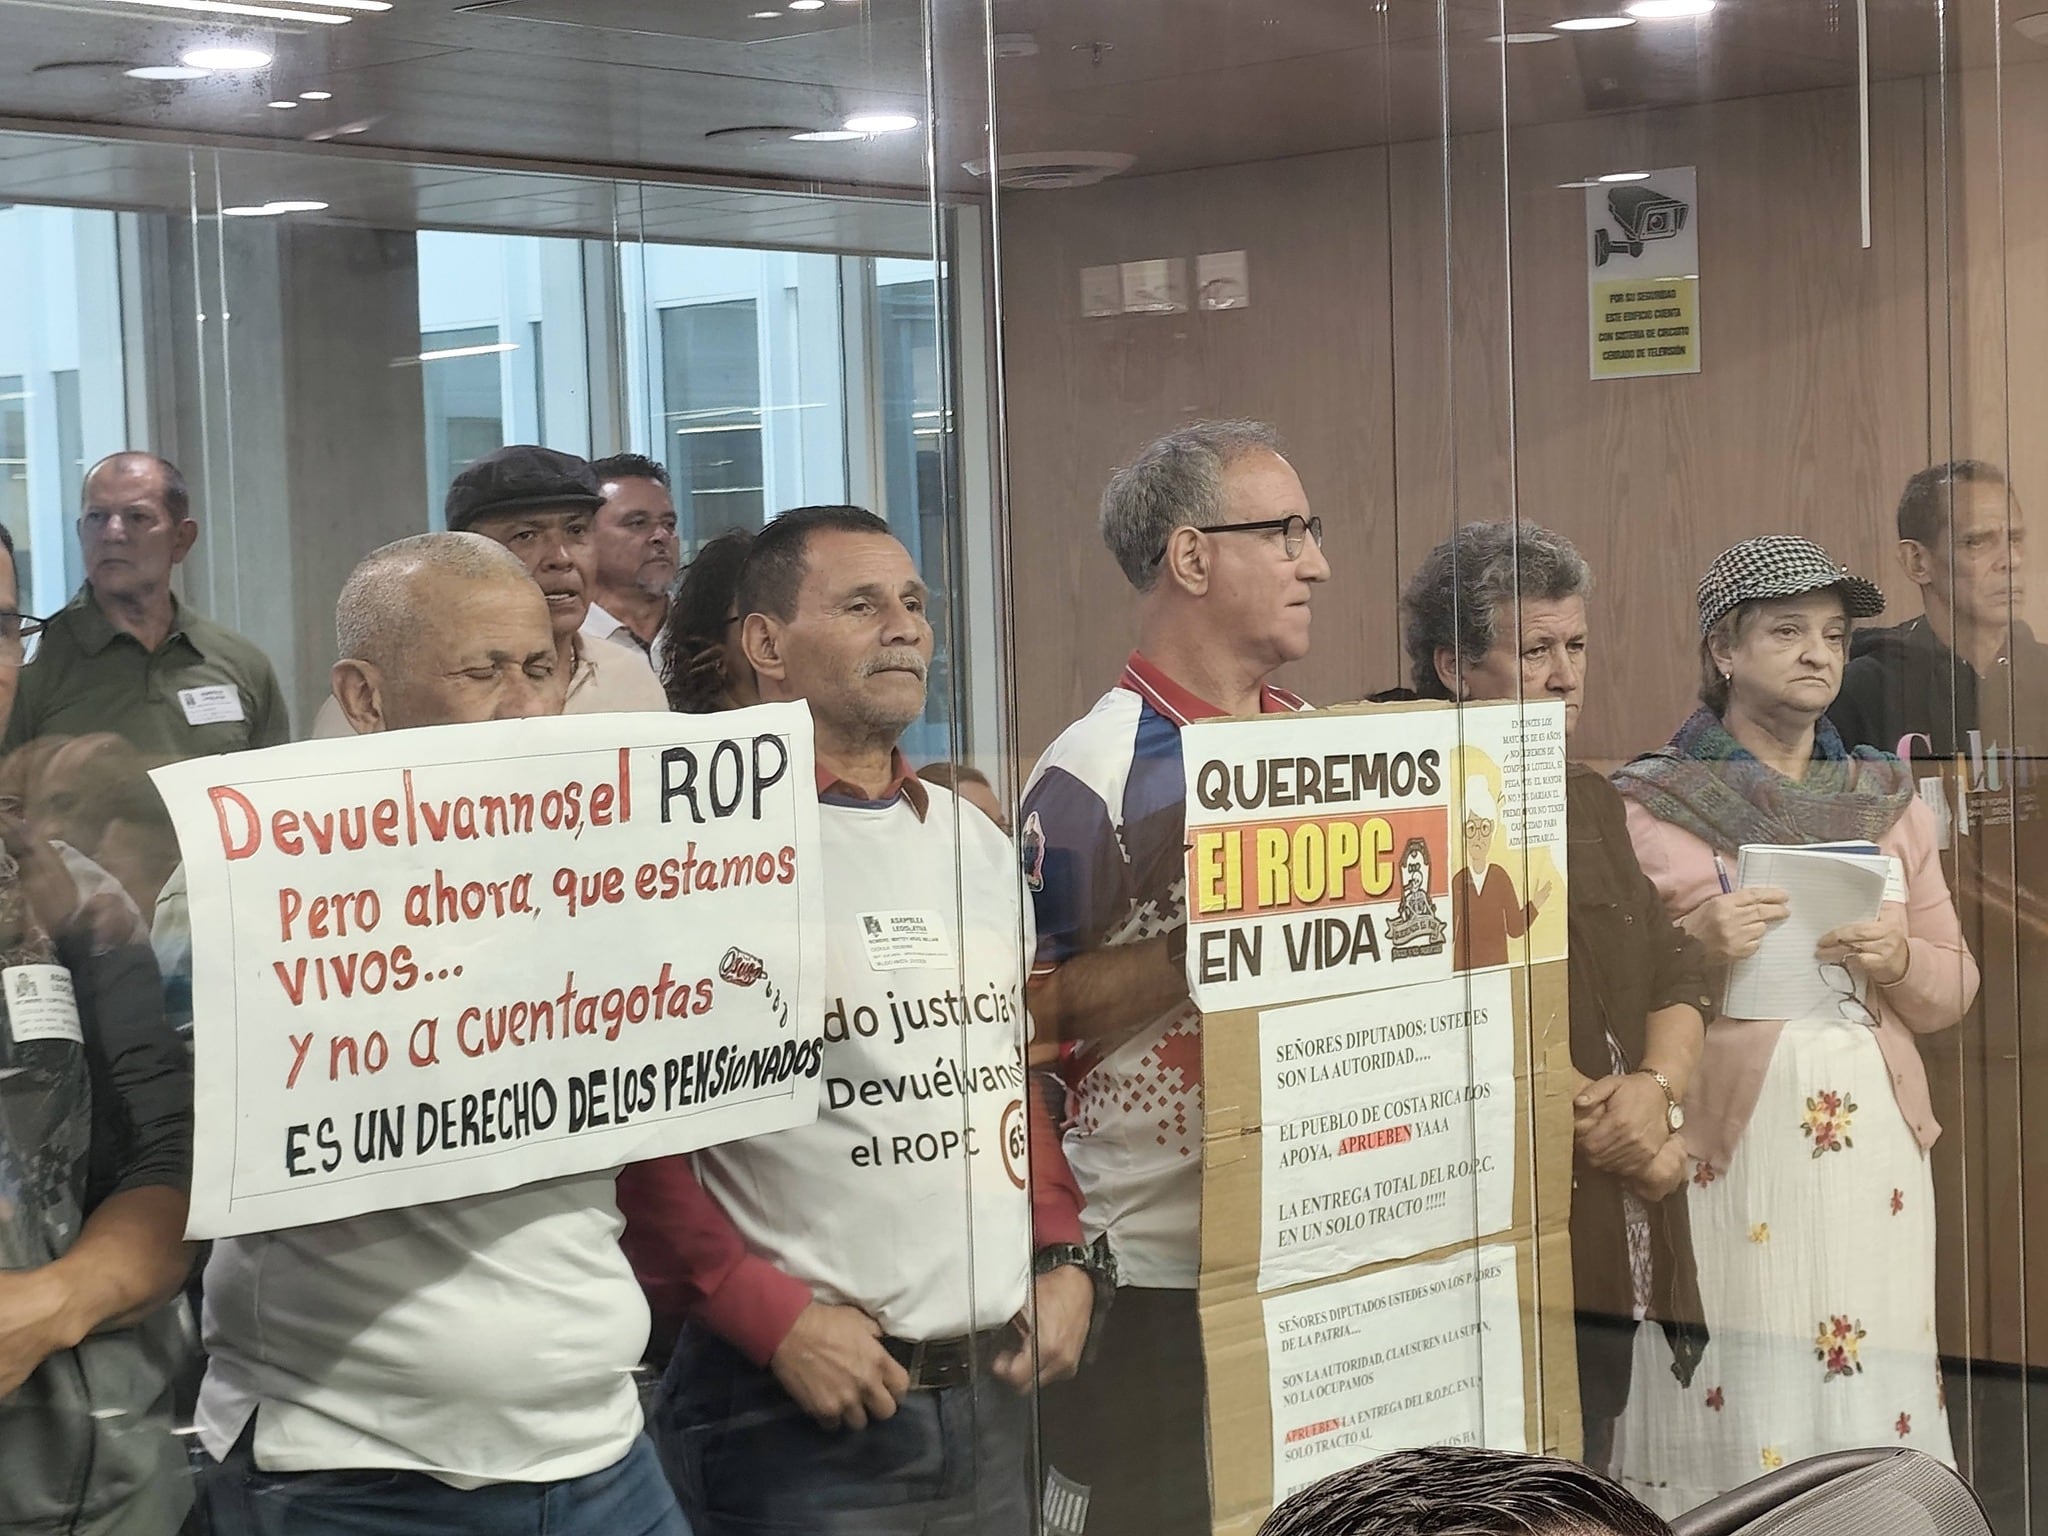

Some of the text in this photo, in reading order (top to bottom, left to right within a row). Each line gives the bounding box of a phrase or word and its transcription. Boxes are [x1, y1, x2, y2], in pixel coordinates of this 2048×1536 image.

[660, 733, 788, 824] ROP
[1196, 748, 1442, 812] QUEREMOS
[553, 867, 625, 917] que
[635, 841, 796, 901] estamos
[1256, 817, 1394, 908] ROPC
[1199, 914, 1381, 985] EN VIDA
[329, 1030, 389, 1081] no
[1276, 1008, 1489, 1063] SEÑORES DIPUTADOS: USTEDES
[1277, 1067, 1307, 1090] SON
[1310, 1064, 1330, 1083] LA
[285, 1116, 343, 1178] ES
[354, 1104, 406, 1164] UN
[416, 1077, 557, 1156] DERECHO
[1280, 1124, 1298, 1142] EL
[1301, 1110, 1358, 1138] PUEBLO
[1362, 1105, 1381, 1125] DE
[1383, 1096, 1428, 1120] COSTA
[1430, 1089, 1461, 1110] RICA
[1337, 1123, 1413, 1156] APRUEBEN
[1415, 1117, 1449, 1138] YAAA
[851, 1136, 882, 1167] el
[1279, 1202, 1298, 1221] LA
[1302, 1186, 1371, 1216] ENTREGA
[1375, 1174, 1418, 1199] TOTAL
[1420, 1167, 1445, 1188] DEL
[1278, 1226, 1298, 1248] EN
[1302, 1221, 1322, 1242] UN
[1325, 1211, 1366, 1236] SOLO
[1368, 1197, 1423, 1226] TRACTO
[1278, 1311, 1328, 1334] SEÑORES
[1329, 1296, 1387, 1322] DIPUTADOS
[1388, 1285, 1429, 1307] USTEDES
[1429, 1280, 1448, 1296] SON
[1447, 1274, 1465, 1290] LOS
[1281, 1338, 1297, 1352] DE
[1298, 1336, 1312, 1348] LA
[1282, 1372, 1305, 1389] SON
[1305, 1369, 1321, 1383] LA
[1283, 1372, 1374, 1408] NO LA OCUPAMOS
[1284, 1417, 1340, 1445] APRUEBEN
[1341, 1415, 1357, 1428] LA
[1357, 1400, 1403, 1424] ENTREGA
[1404, 1393, 1425, 1410] DEL
[1284, 1427, 1373, 1463] SOLO TRACTO AL
